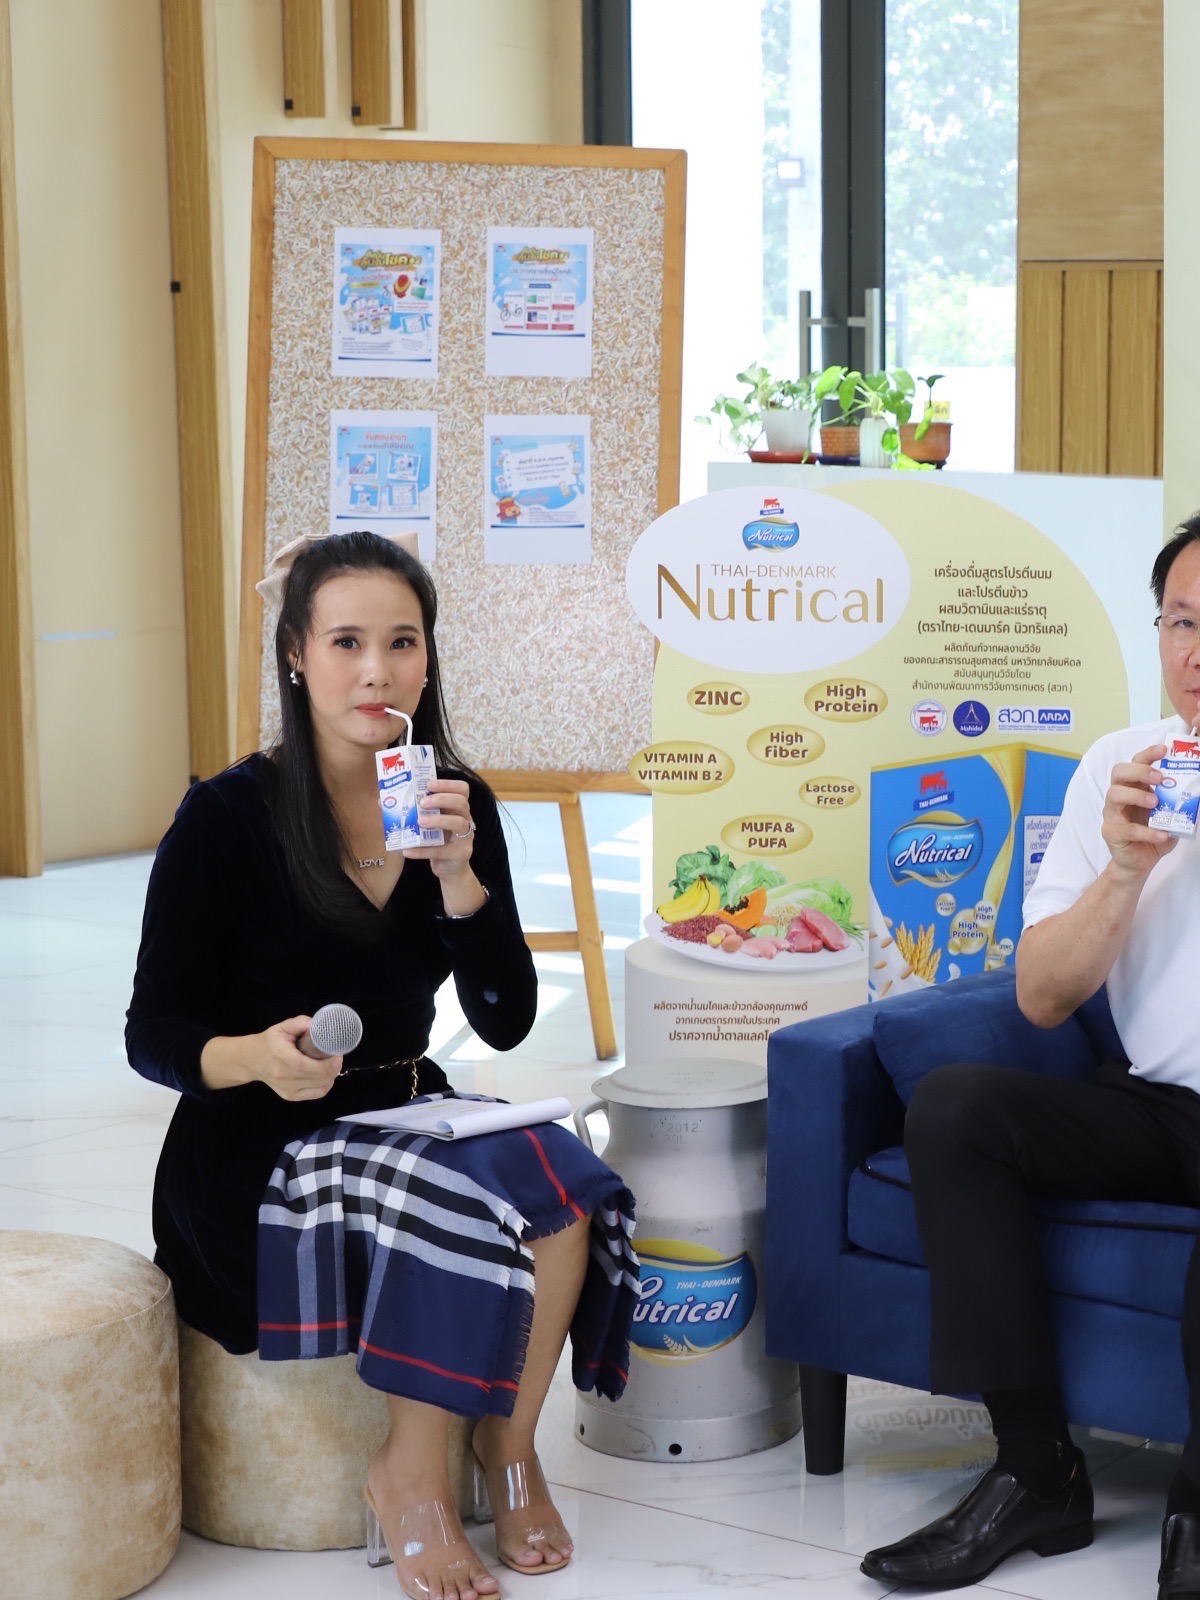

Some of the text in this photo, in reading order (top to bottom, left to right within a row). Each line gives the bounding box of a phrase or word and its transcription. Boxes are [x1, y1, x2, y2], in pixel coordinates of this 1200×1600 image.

[748, 528, 794, 541] Nutrical
[711, 563, 836, 579] THAI-DENMARK
[934, 561, 1052, 582] เครื่องดื่มสูตรโปรตีนนม
[657, 563, 884, 623] Nutrical
[958, 585, 1029, 599] และโปรตีนข้าว
[938, 603, 1047, 620] ผสมวิตามินและแร่ธาตุ
[917, 620, 1068, 637] (ตราไทย-เดนมาร์ค นิวทริแคล)
[944, 642, 1041, 653] ผลิตภัณฑ์จากผลงานวิจัย
[903, 655, 1082, 668] ของคณะสาธารณสุขศาสตร์ มหาวิทยาลัยมหิดล
[953, 669, 1032, 682] สนับสนุนทุนวิจัยโดย
[826, 684, 867, 700] High
[912, 680, 1073, 694] สำนักงานพัฒนาการวิจัยการเกษตร (สวก.)
[694, 691, 743, 706] ZINC
[814, 700, 879, 713] Protein
[998, 709, 1037, 724] สวก.
[1039, 712, 1070, 722] ARDA
[769, 732, 804, 746] High
[643, 753, 718, 764] VITAMIN A
[638, 770, 723, 781] VITAMIN B 2
[805, 783, 855, 794] Lactose
[816, 795, 844, 805] Free
[741, 822, 795, 833] MUFA &
[748, 837, 788, 849] PUFA
[894, 833, 973, 868] Nutrical
[359, 858, 385, 868] LOVE
[958, 922, 978, 930] High
[653, 998, 808, 1014] ผลิตจากน้ำนมโคและข้าวกล้องคุณภาพดี
[675, 1016, 781, 1025] จากเกษตรกรภายในประเทศ
[669, 1026, 772, 1041] ปราศจากน้ำตาลแลคโ
[676, 1281, 696, 1290] THAI
[701, 1276, 742, 1289] DENMARK
